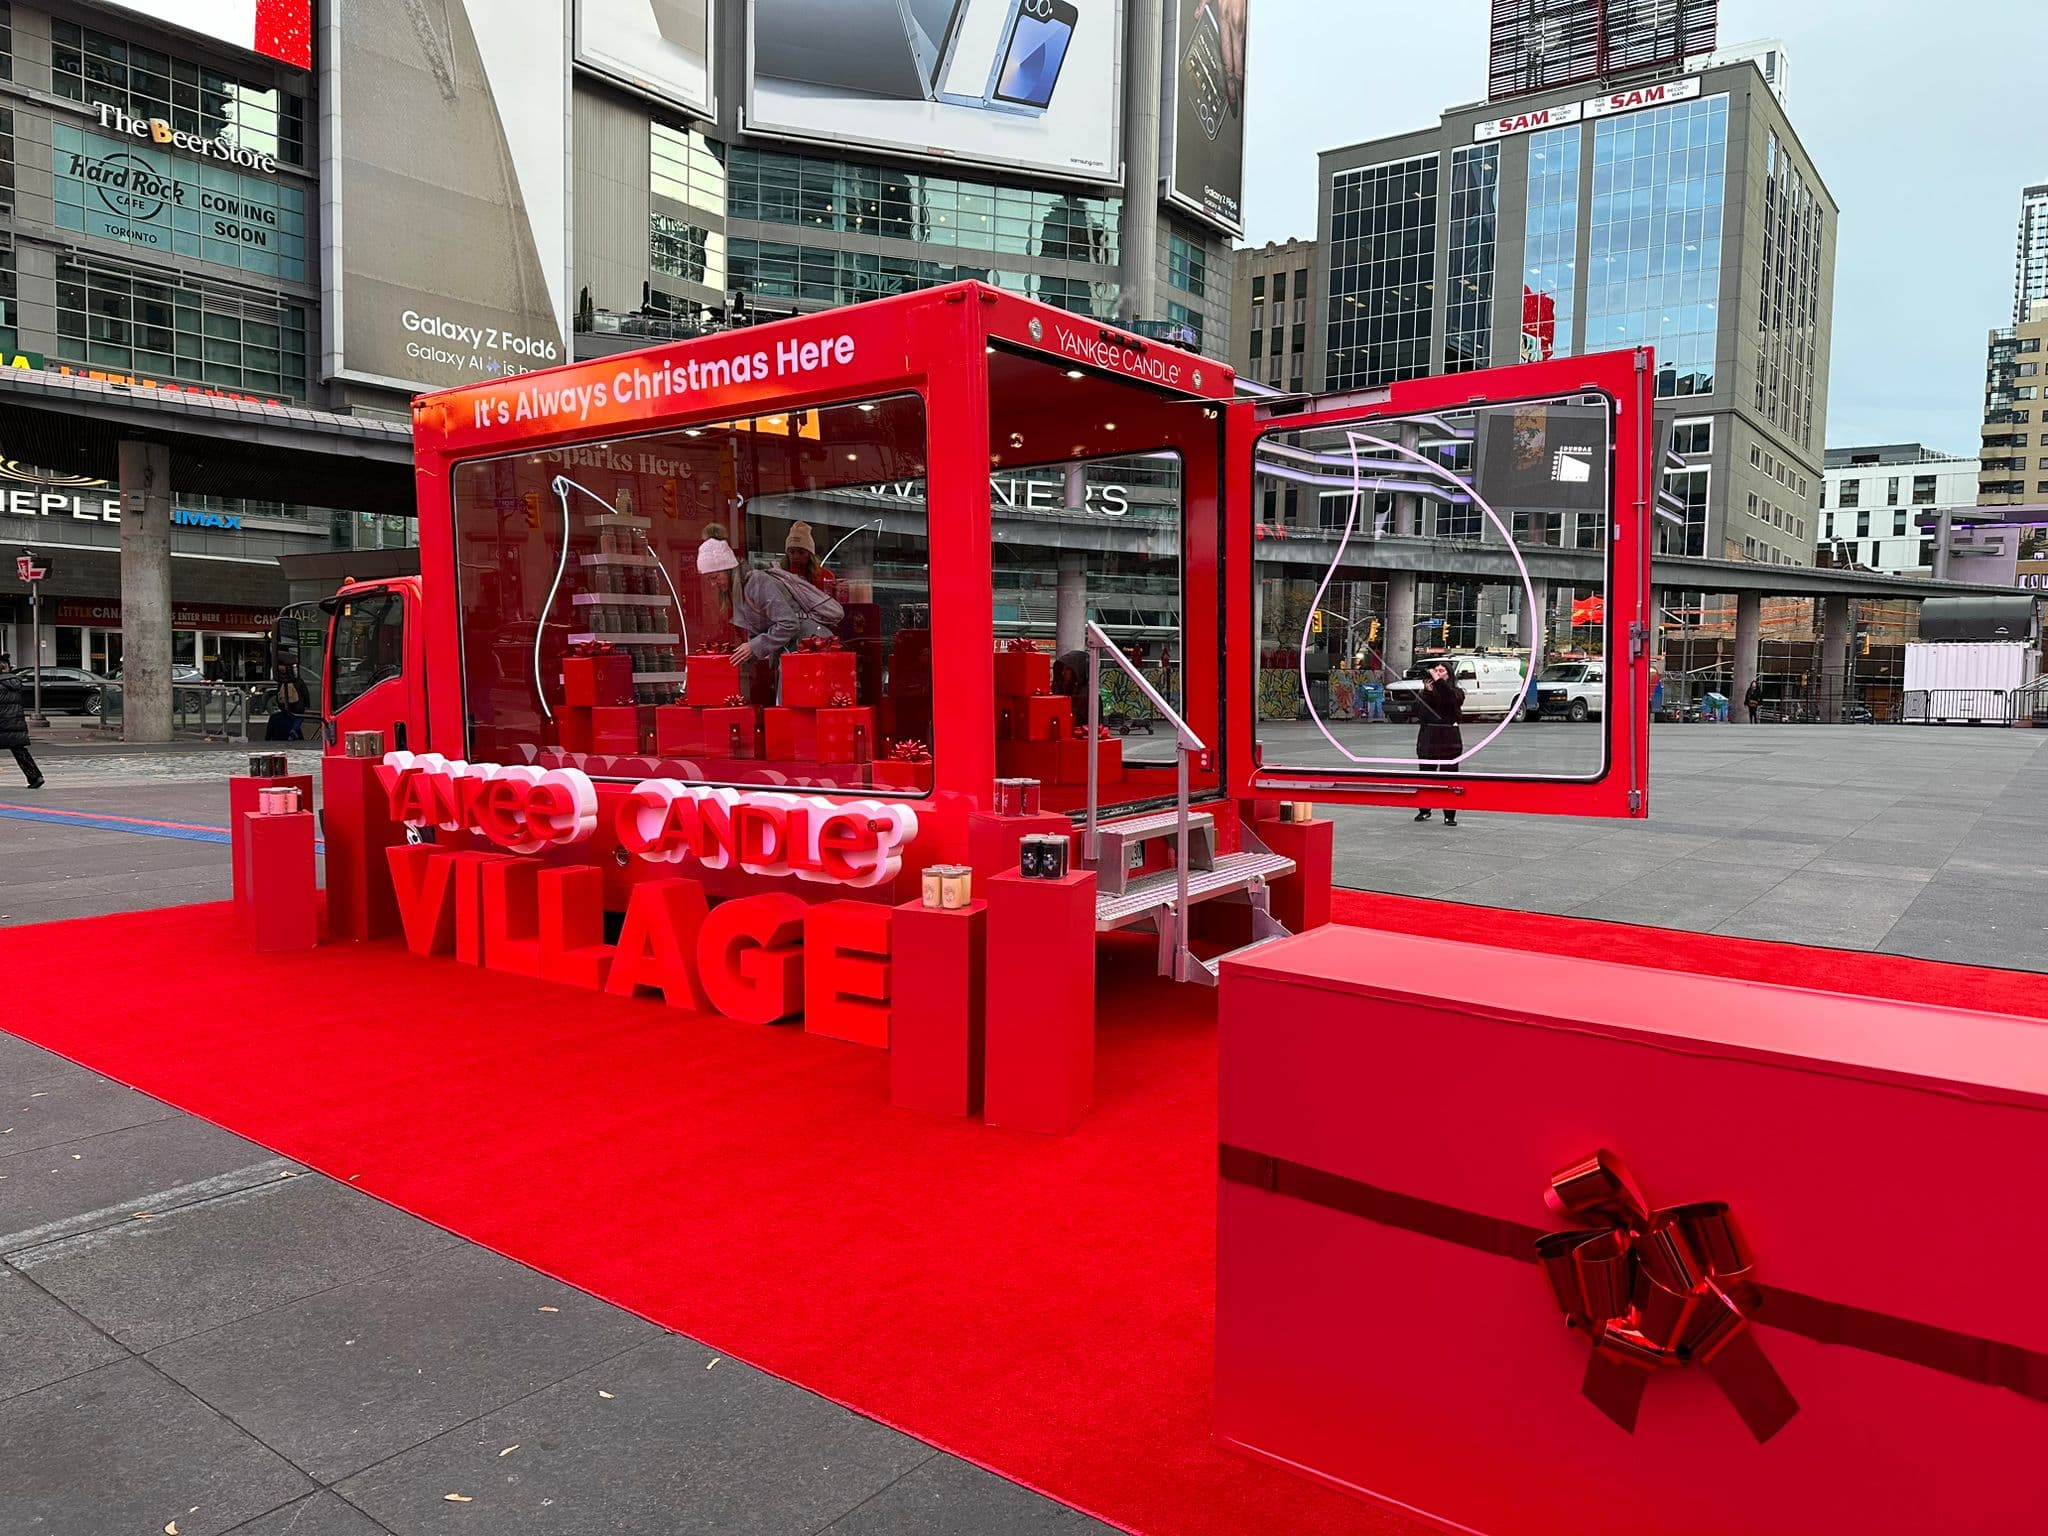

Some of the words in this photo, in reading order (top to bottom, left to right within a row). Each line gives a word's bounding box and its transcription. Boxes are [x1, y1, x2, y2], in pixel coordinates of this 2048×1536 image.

[1610, 86, 1664, 109] SAM
[1499, 110, 1549, 132] SAM
[93, 100, 148, 138] The
[150, 117, 213, 155] Beer
[213, 136, 277, 174] Store
[68, 153, 129, 187] Hard
[131, 170, 185, 206] Rock
[115, 194, 146, 210] CAFE
[201, 193, 276, 226] COMING
[105, 223, 158, 244] TORONTO
[214, 220, 267, 246] SOON
[857, 271, 903, 293] DMZ
[401, 310, 483, 350] Galaxy
[486, 328, 498, 349] Z
[502, 331, 557, 360] Fold6
[406, 342, 466, 371] Galaxy
[469, 356, 483, 371] AI
[474, 397, 510, 429] It's
[515, 382, 607, 422] Always
[613, 350, 768, 405] Christmas
[776, 334, 855, 376] Here
[639, 453, 692, 479] Here
[175, 510, 241, 530] IMAX
[177, 612, 200, 622] ENTER
[201, 613, 220, 623] HERE
[386, 842, 892, 1051] VILLAGE
